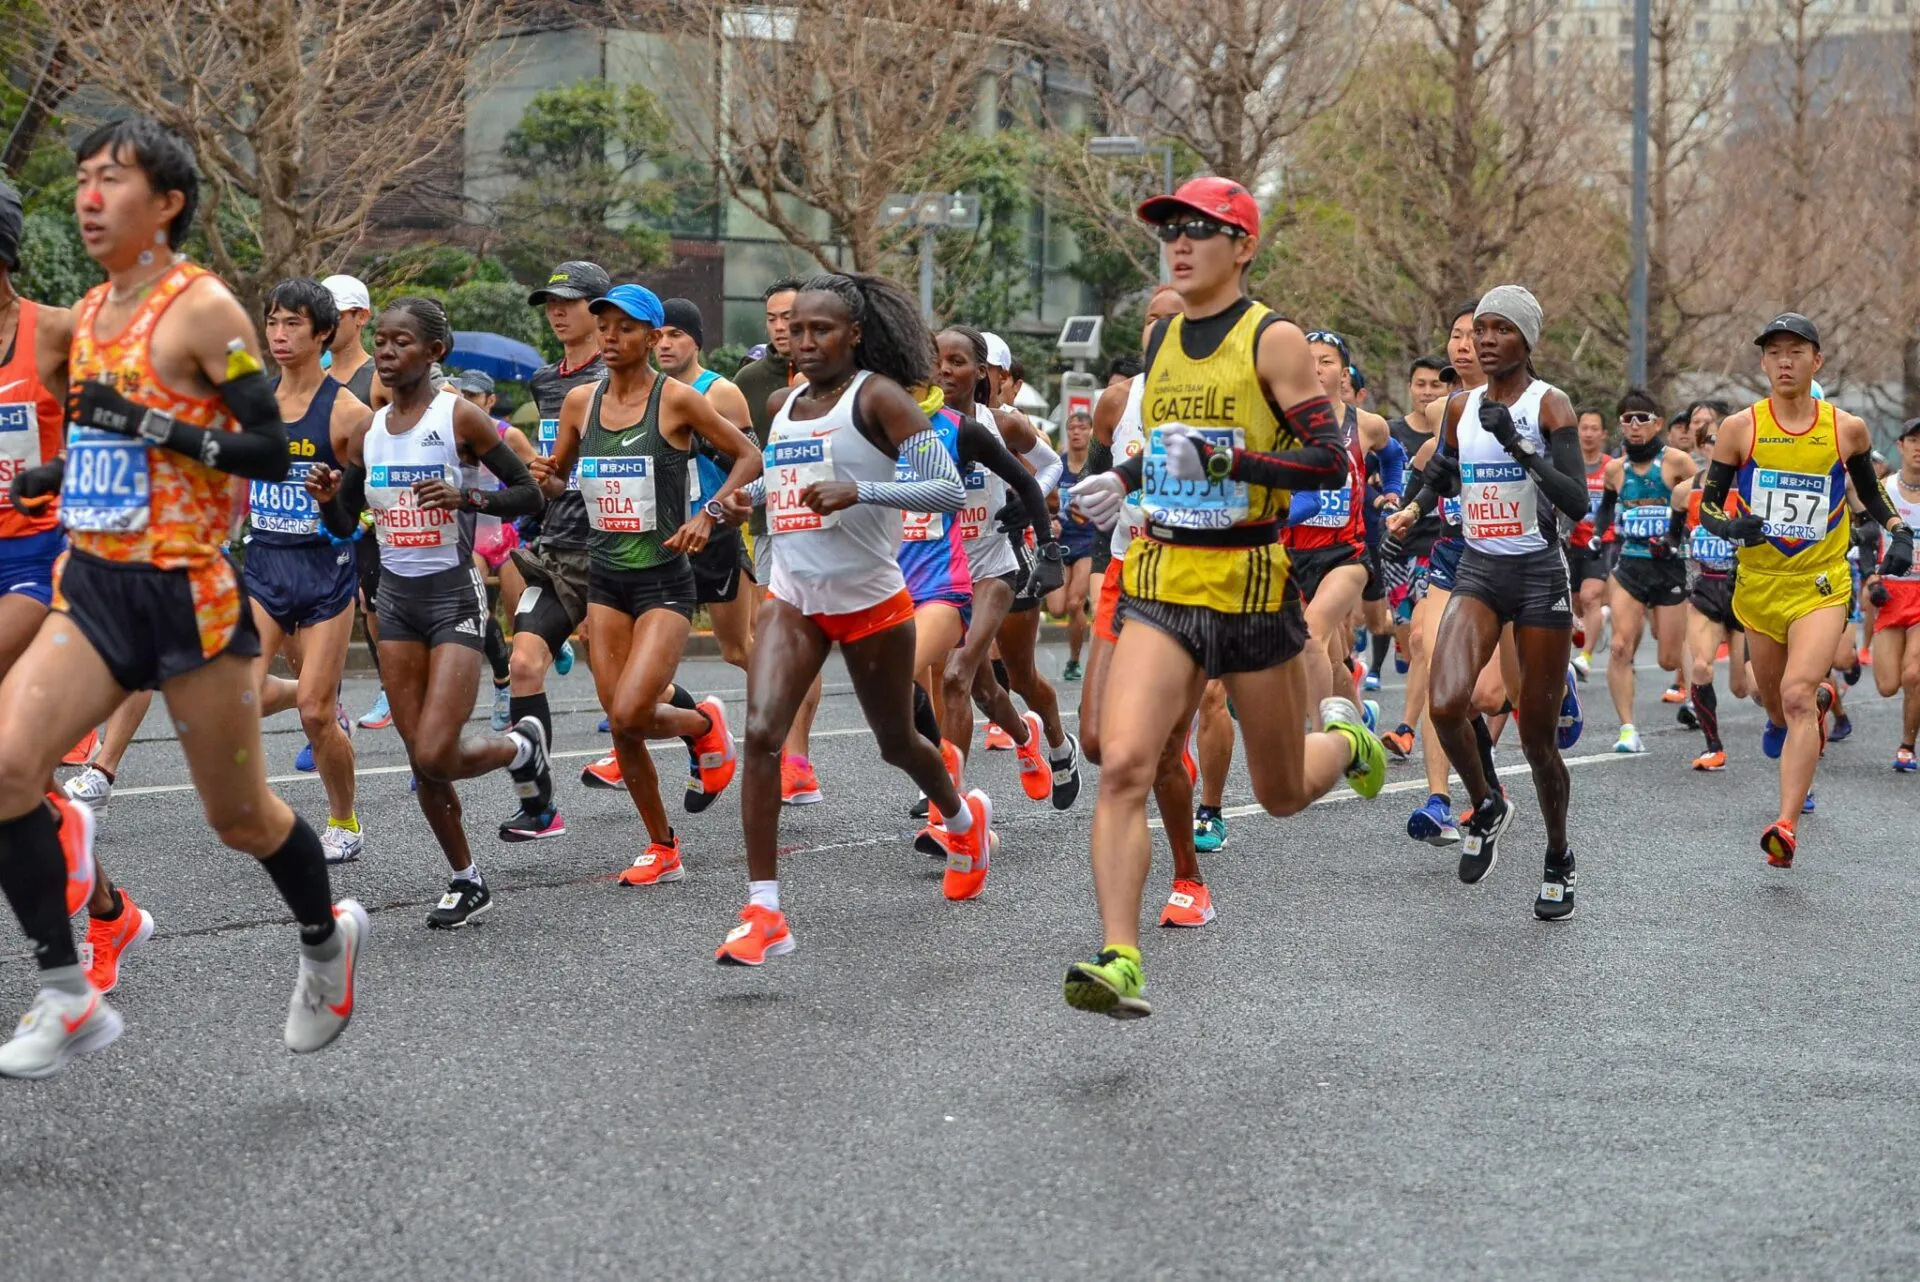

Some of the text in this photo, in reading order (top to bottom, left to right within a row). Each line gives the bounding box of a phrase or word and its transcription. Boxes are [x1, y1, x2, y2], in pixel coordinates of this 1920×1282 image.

[1184, 384, 1204, 392] TEAM
[1152, 385, 1236, 422] GAZELLE
[421, 440, 445, 448] adidas
[776, 445, 821, 460] 東京メトロ
[600, 463, 643, 474] 東京メトロ
[1476, 467, 1523, 478] 東京メトロ
[391, 470, 442, 483] 東京メトロ
[781, 468, 798, 486] 54
[1779, 475, 1823, 489] 東京メトロ
[605, 480, 622, 495] 59
[1482, 485, 1500, 501] 62
[250, 480, 309, 512] A4805
[398, 490, 415, 507] 61
[1320, 489, 1342, 511] 55
[596, 497, 635, 514] TOLA
[1467, 501, 1521, 521] MELLY
[1763, 491, 1821, 525] 157
[374, 508, 455, 528] CHEBITOK
[604, 519, 639, 529] ヤマザキ
[1480, 524, 1521, 535] ヤマザキ
[1624, 519, 1664, 538] A4618
[395, 533, 438, 545] ヤマザキ
[455, 626, 479, 635] adidas
